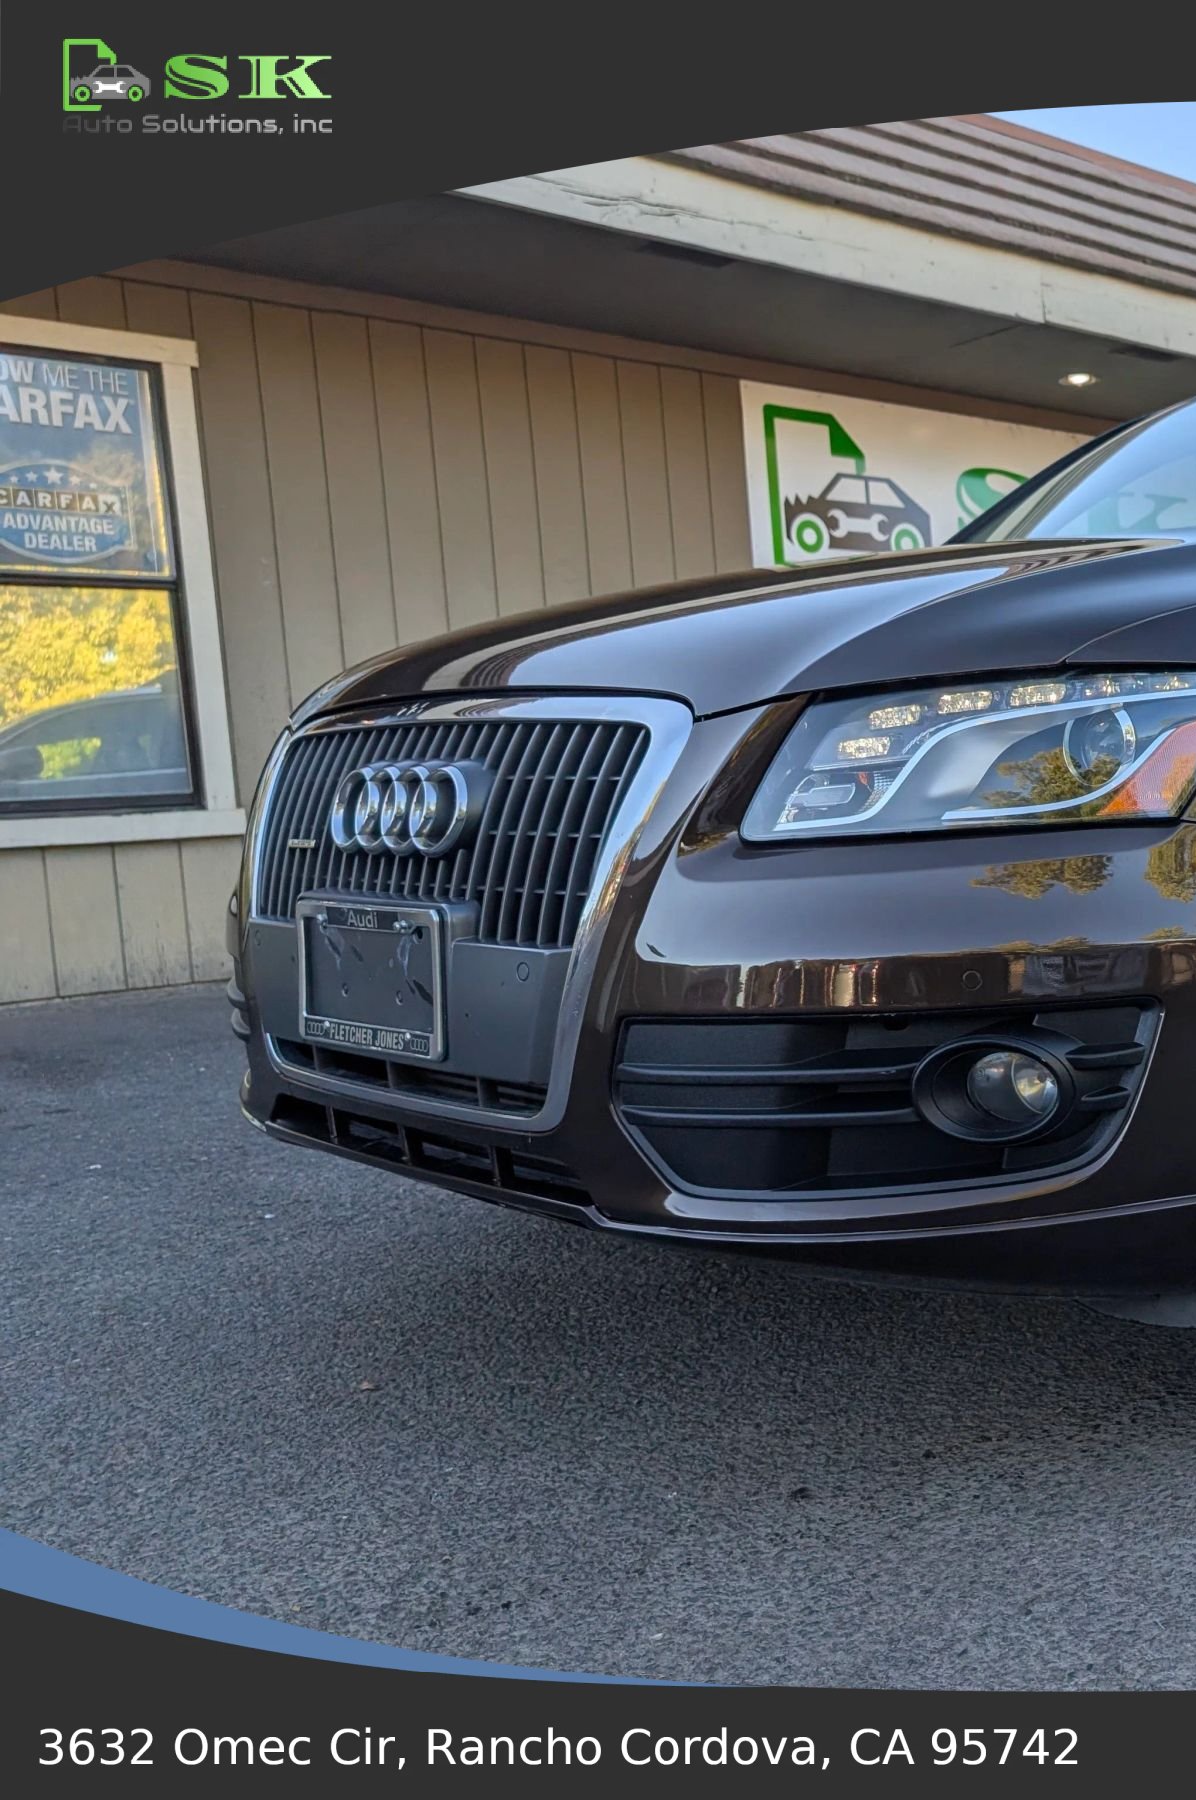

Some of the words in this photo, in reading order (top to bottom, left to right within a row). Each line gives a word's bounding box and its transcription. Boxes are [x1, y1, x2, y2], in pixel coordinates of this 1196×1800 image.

[43, 363, 79, 389] ME
[84, 368, 128, 395] THE
[0, 383, 133, 435] ARFAX
[3, 511, 115, 536] ADVANTAGE
[24, 531, 97, 553] DEALER
[347, 909, 378, 929] Audi
[329, 1022, 373, 1046] FLETCHER
[375, 1030, 404, 1050] JONES
